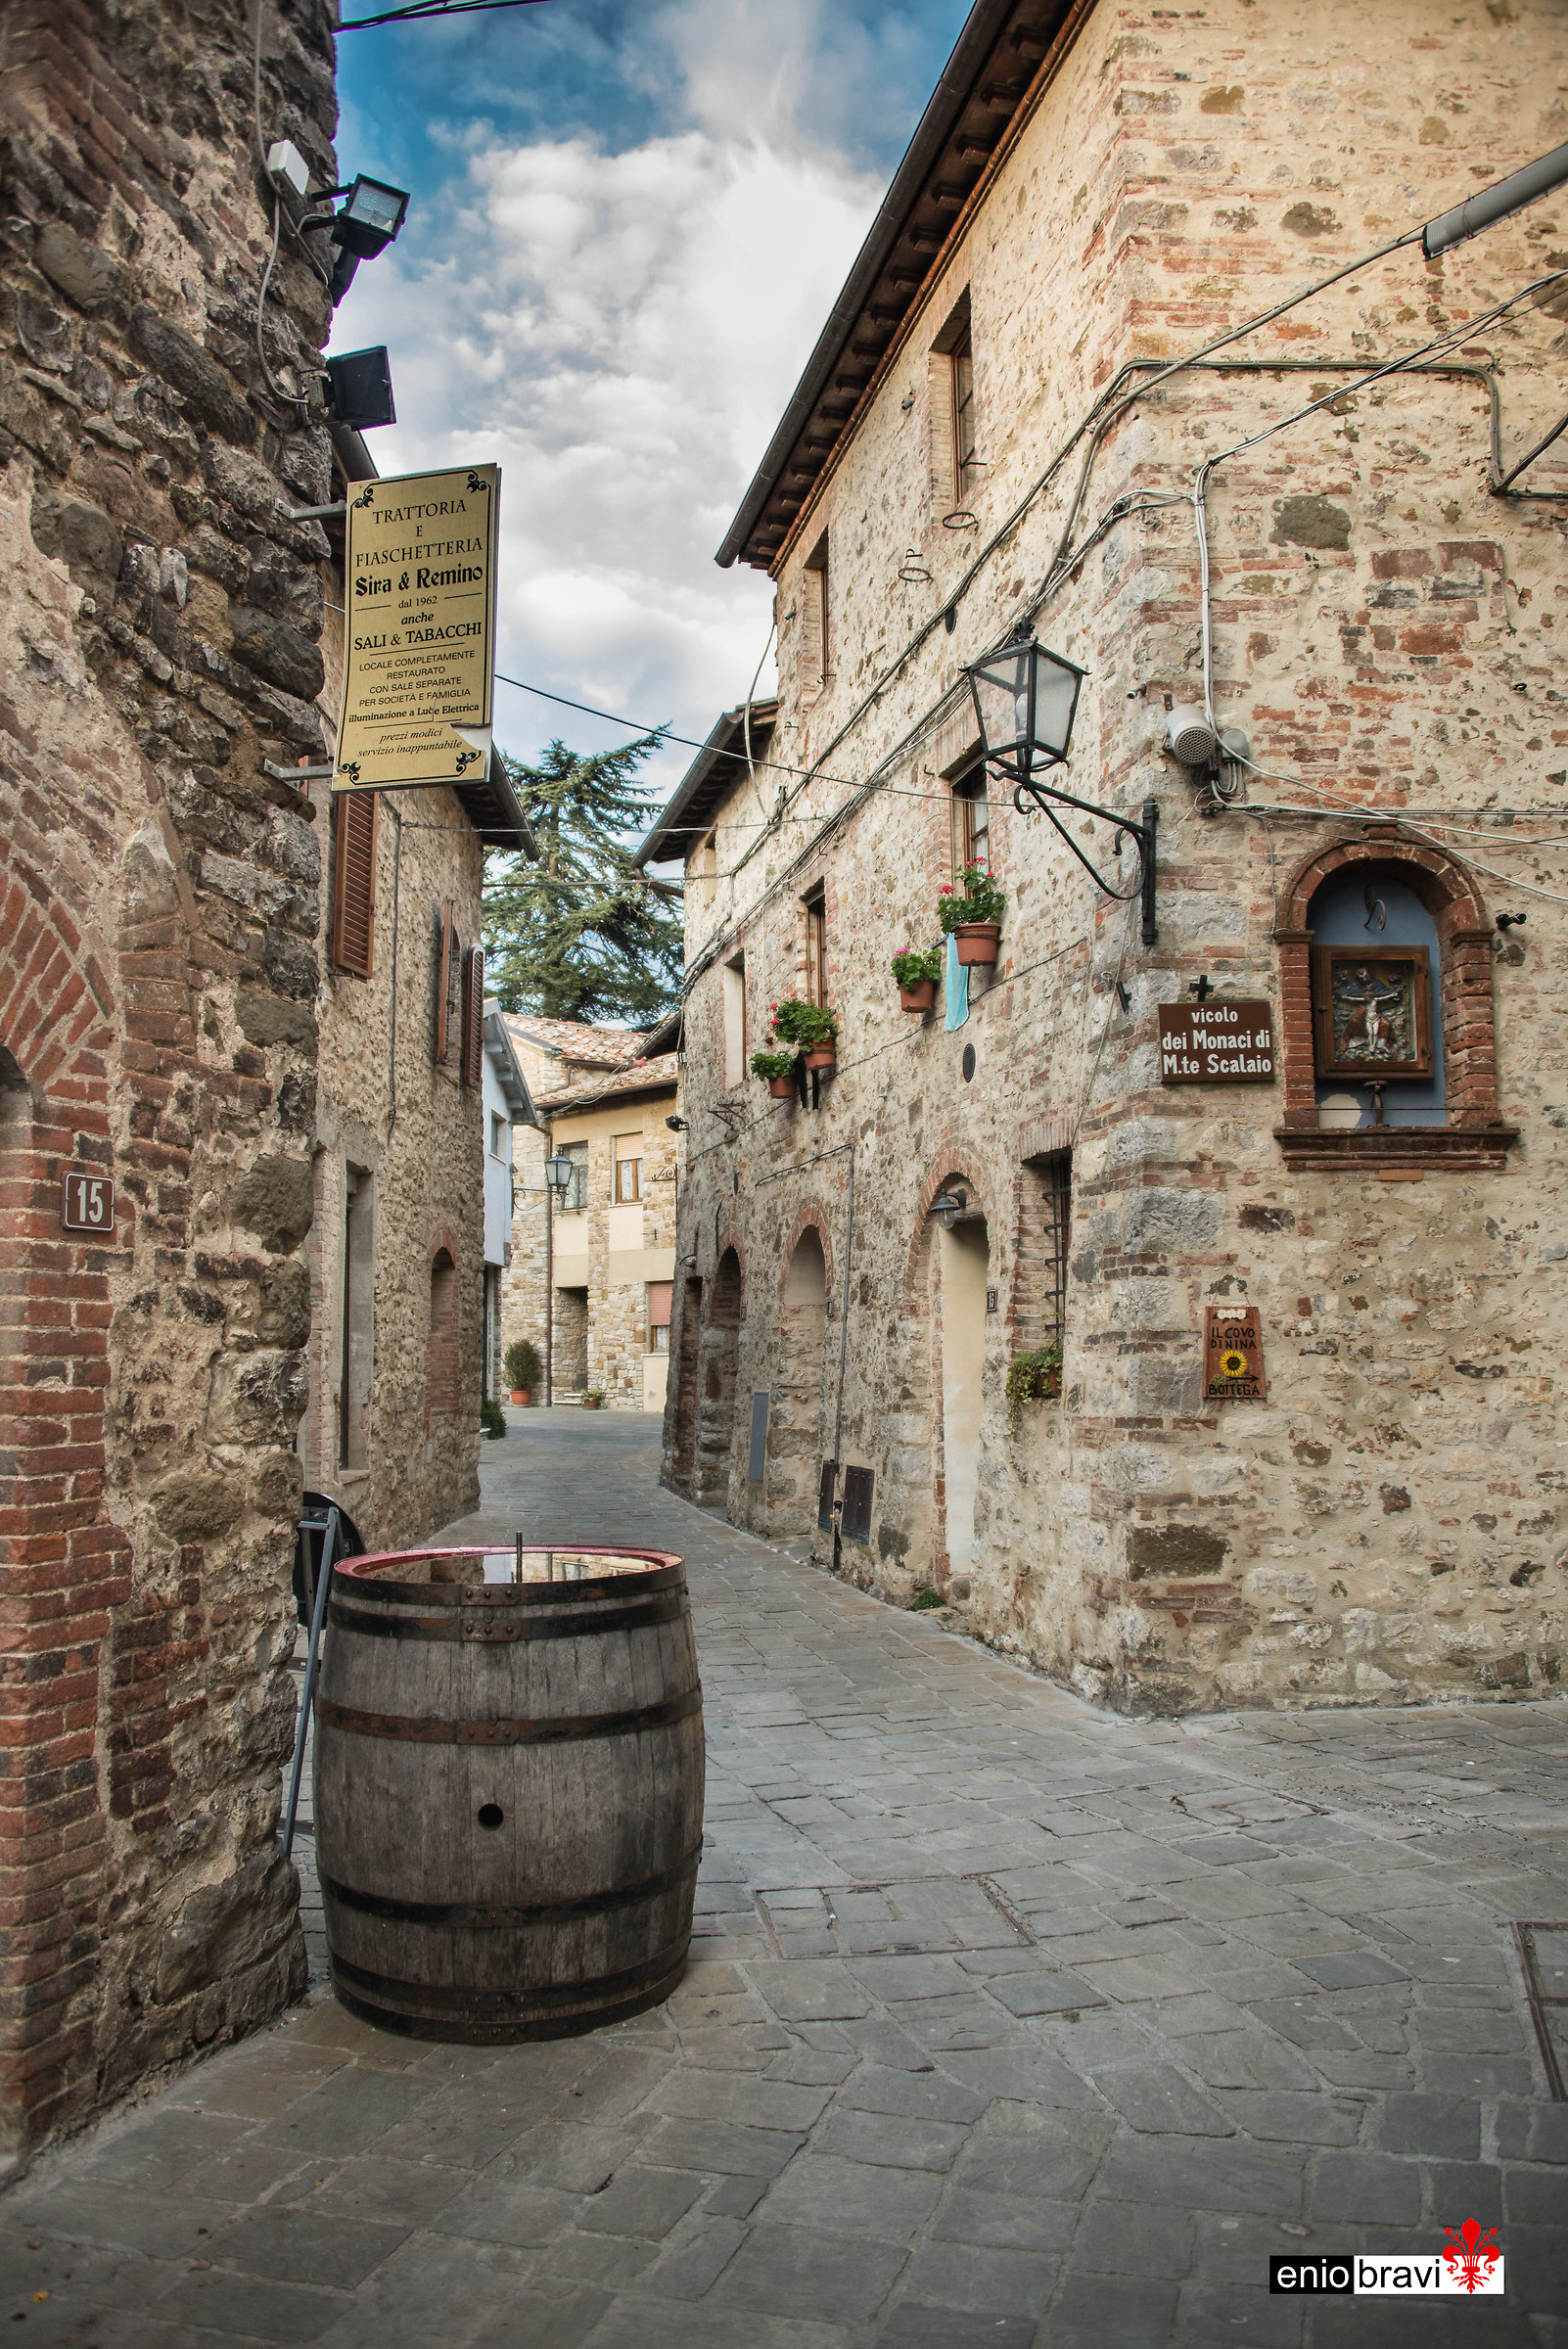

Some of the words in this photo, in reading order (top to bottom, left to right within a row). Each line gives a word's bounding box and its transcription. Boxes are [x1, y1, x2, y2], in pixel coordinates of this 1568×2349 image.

[373, 500, 467, 524] TRATTORIA
[416, 526, 423, 537] E
[355, 537, 483, 567] FIASCHETTERIA
[355, 576, 392, 596] Sira
[398, 572, 410, 591] &
[416, 563, 484, 589] Remino
[398, 599, 412, 609] dal
[416, 595, 438, 607] 1962
[400, 612, 434, 624] anche
[354, 634, 387, 651] SALI
[391, 634, 401, 646] &
[405, 622, 483, 644] TABACCHI
[359, 660, 392, 671] LOCALE
[394, 650, 476, 668] COMPLETAMENTE
[387, 667, 446, 680] RESTAURATO
[369, 685, 389, 694] CON
[391, 682, 413, 692] SALE
[415, 676, 462, 689] SEPARATE
[359, 698, 376, 707] PER
[378, 692, 417, 706] SOCIETÀ
[427, 688, 471, 700] FAMIGLIA
[348, 709, 407, 723] illuminazione
[417, 706, 439, 715] Luce
[441, 703, 480, 714] Elettrica
[379, 731, 408, 744] prezzi
[410, 728, 442, 739] modici
[357, 746, 394, 758] servizio
[396, 740, 462, 755] inappuntabile
[1191, 1006, 1238, 1023] vicolo
[1162, 1032, 1187, 1050] dei
[1192, 1029, 1252, 1049] Monaci
[1255, 1029, 1270, 1048] di
[1163, 1054, 1200, 1075] M.te
[1207, 1053, 1272, 1074] Scalaio
[77, 1180, 103, 1223] 15
[1212, 1327, 1223, 1338] IL
[1224, 1327, 1256, 1339] COVO
[1211, 1340, 1222, 1349] DI
[1225, 1339, 1257, 1350] NINA
[1209, 1384, 1261, 1396] BOTTEGA
